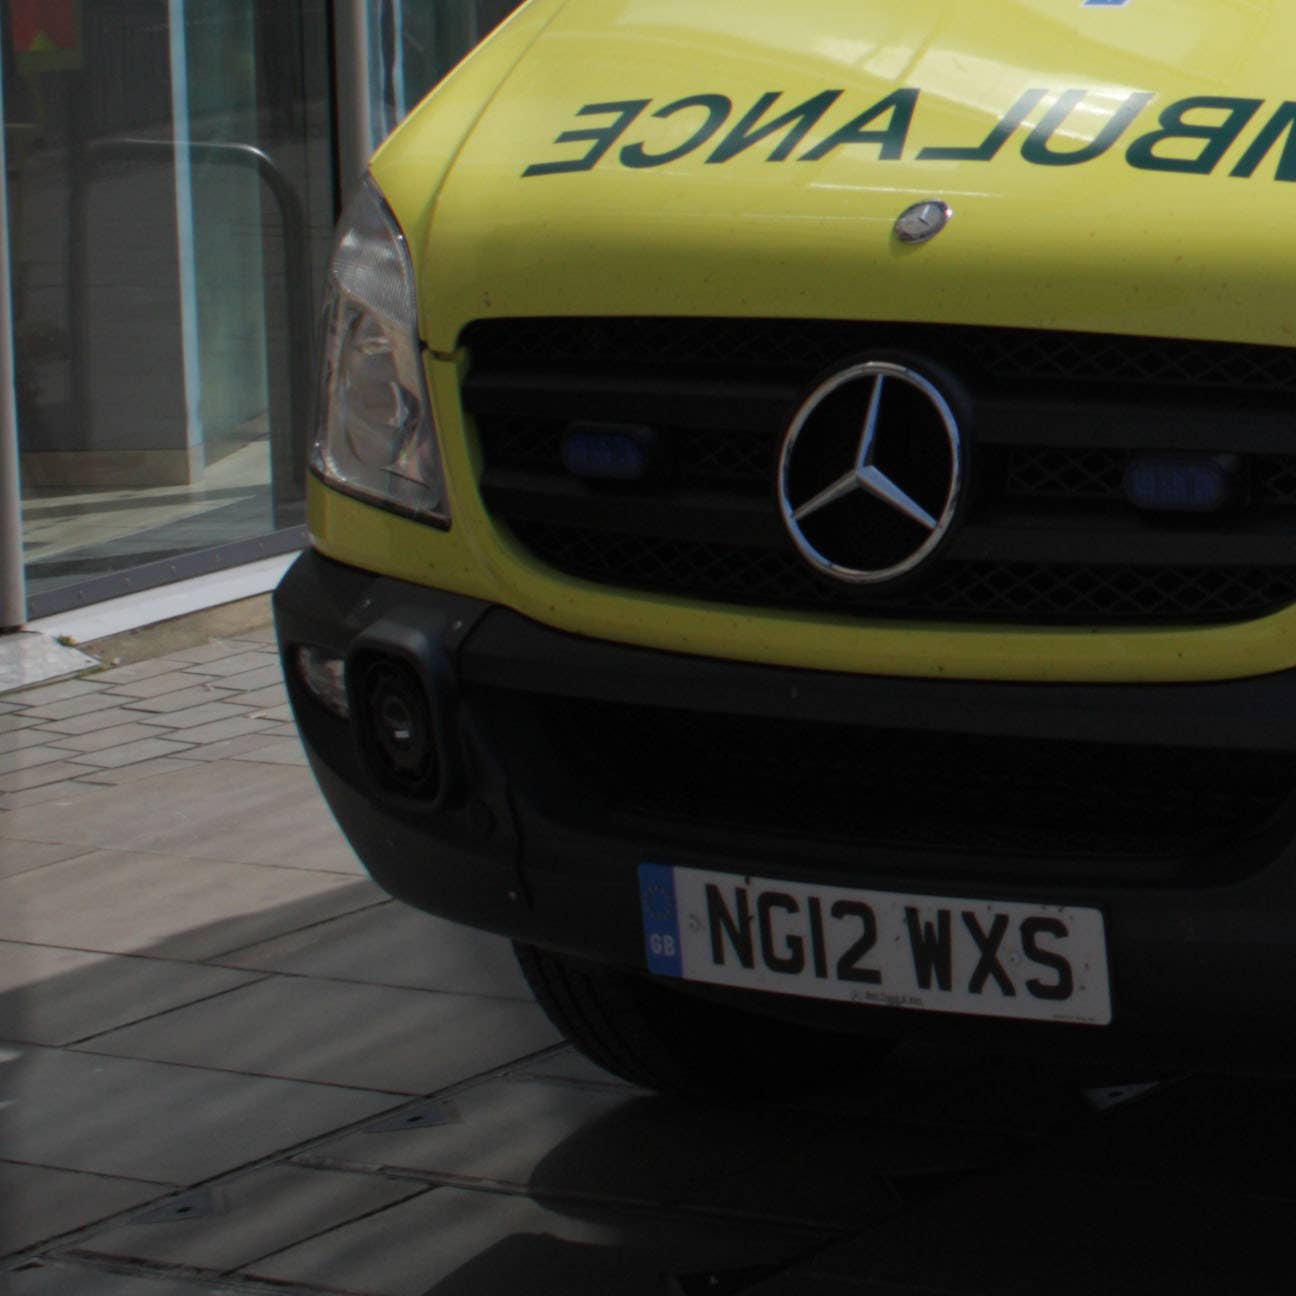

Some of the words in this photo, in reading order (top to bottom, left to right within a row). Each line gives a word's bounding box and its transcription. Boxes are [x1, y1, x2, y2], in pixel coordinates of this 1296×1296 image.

[650, 934, 675, 958] GB
[705, 883, 882, 985] NG12
[905, 906, 1075, 1001] WXS
